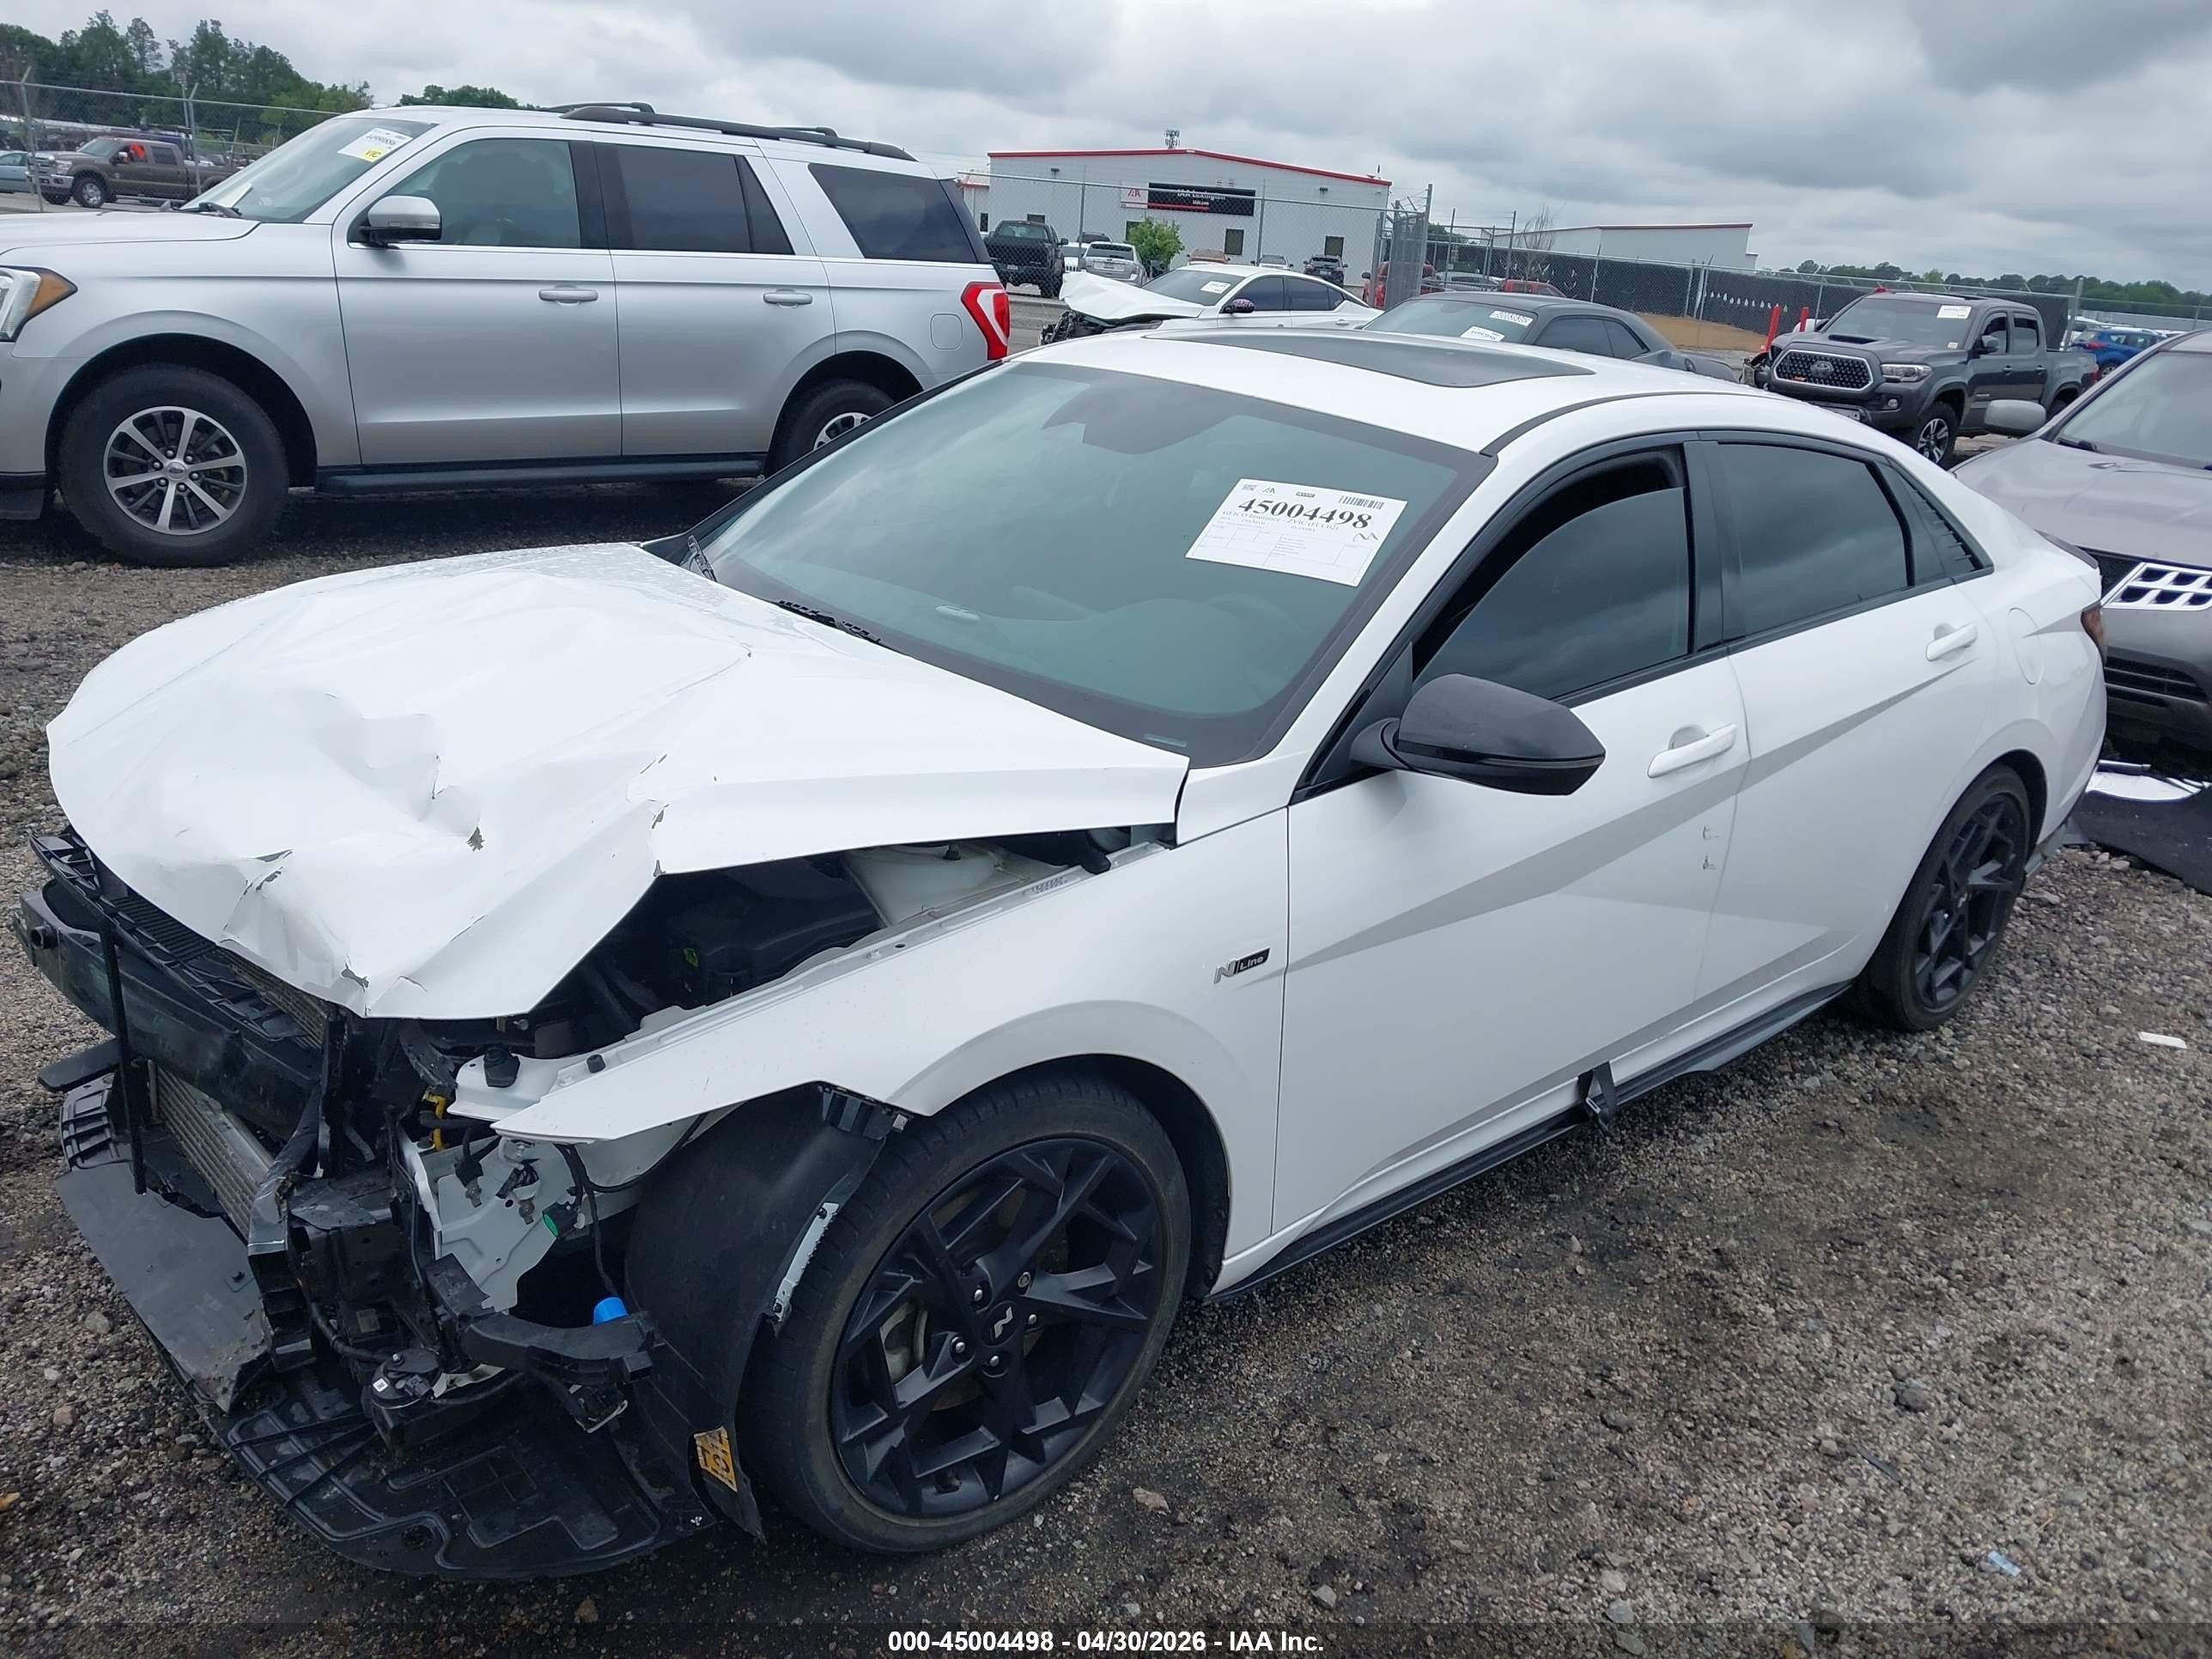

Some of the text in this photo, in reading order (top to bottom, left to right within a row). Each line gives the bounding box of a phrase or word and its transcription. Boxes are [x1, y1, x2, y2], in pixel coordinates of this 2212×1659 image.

[1237, 497, 1373, 529] 45004498
[1213, 956, 1265, 983] N Line
